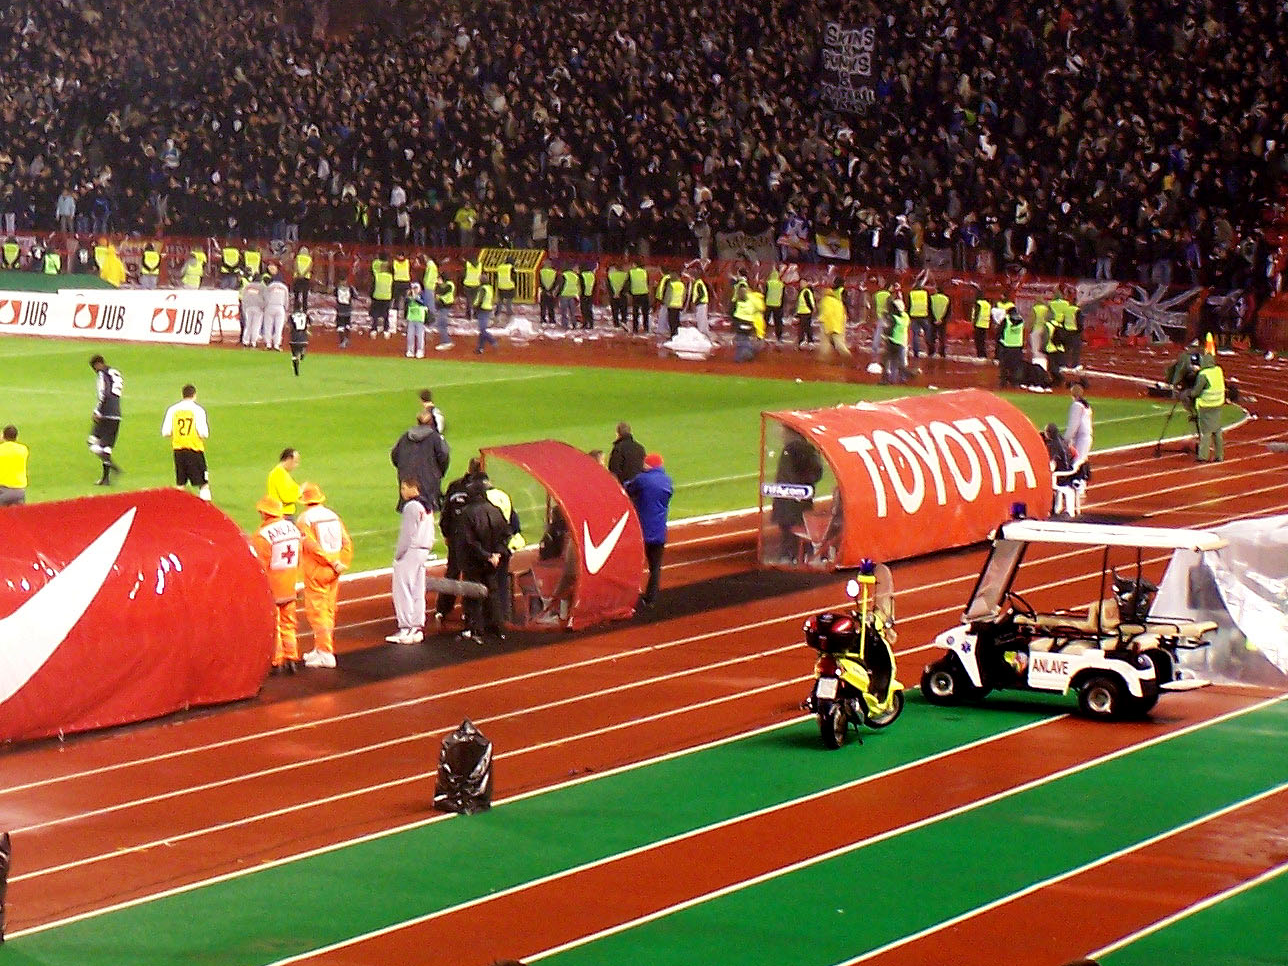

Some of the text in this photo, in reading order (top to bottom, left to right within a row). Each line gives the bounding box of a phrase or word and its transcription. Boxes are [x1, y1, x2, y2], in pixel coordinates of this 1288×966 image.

[20, 300, 49, 326] JUB
[97, 305, 126, 331] JUB
[176, 309, 204, 335] JUB
[177, 417, 194, 436] 27
[838, 415, 1037, 518] TOYOTA
[1032, 658, 1070, 675] ANLAVE
